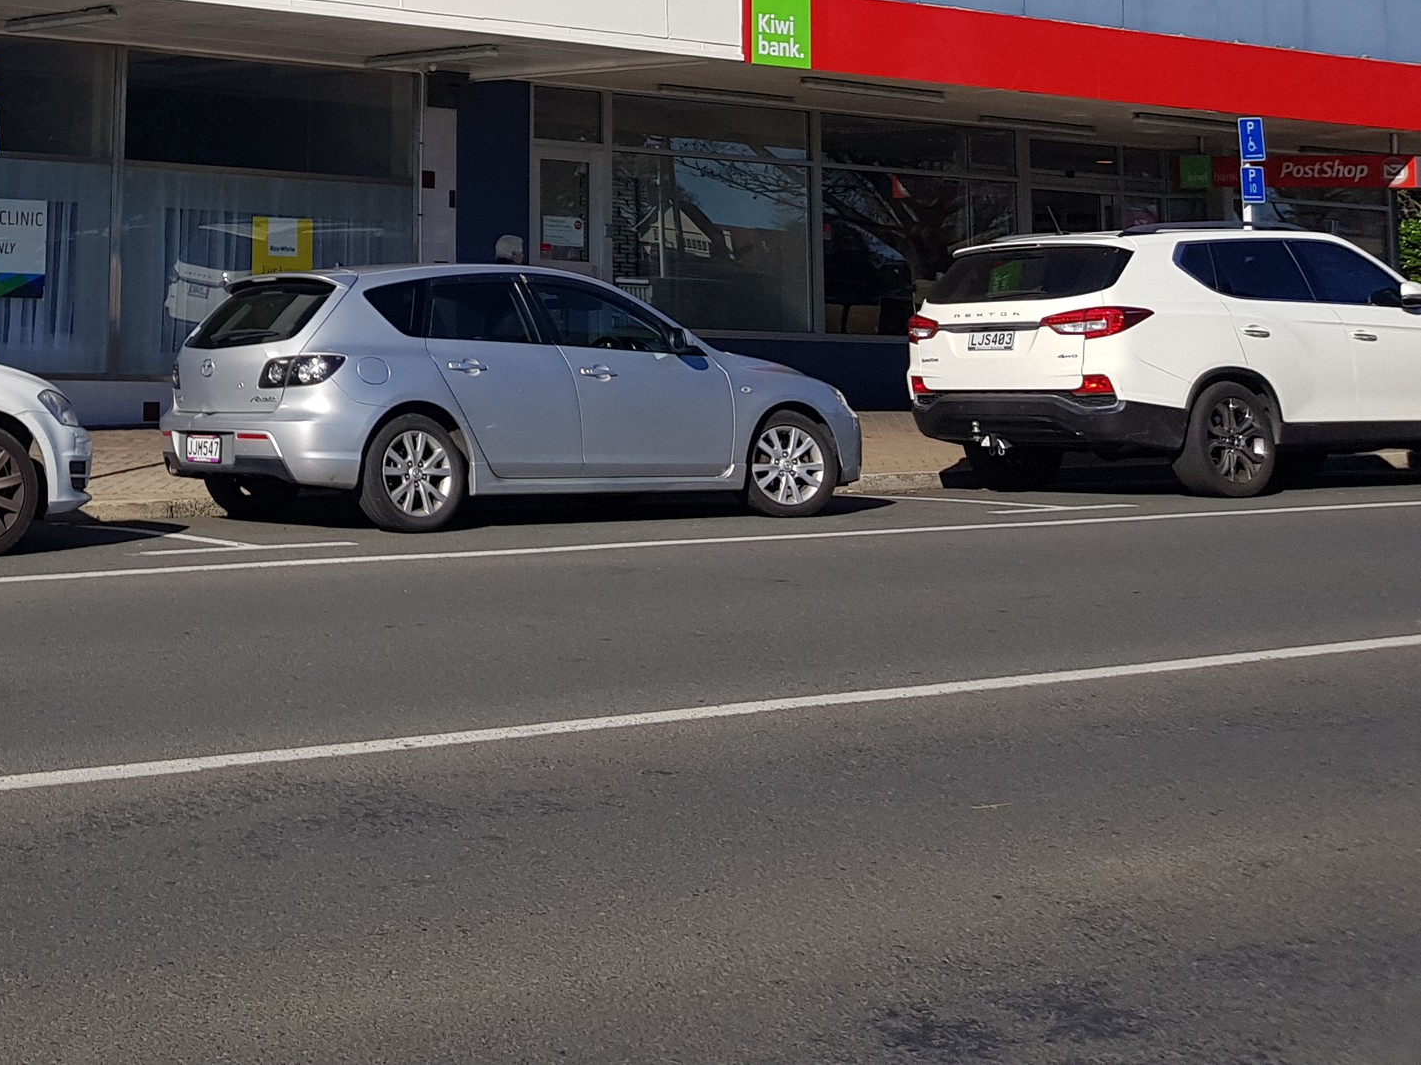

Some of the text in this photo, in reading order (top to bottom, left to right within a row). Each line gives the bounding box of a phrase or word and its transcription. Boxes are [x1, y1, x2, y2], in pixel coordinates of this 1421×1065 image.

[757, 13, 805, 59] Kiwi bank.
[1246, 121, 1254, 135] P
[1248, 168, 1256, 181] P
[1280, 161, 1369, 182] PostShop
[1249, 185, 1258, 194] 10
[0, 210, 44, 228] CLINIC
[970, 333, 1013, 346] LJS403
